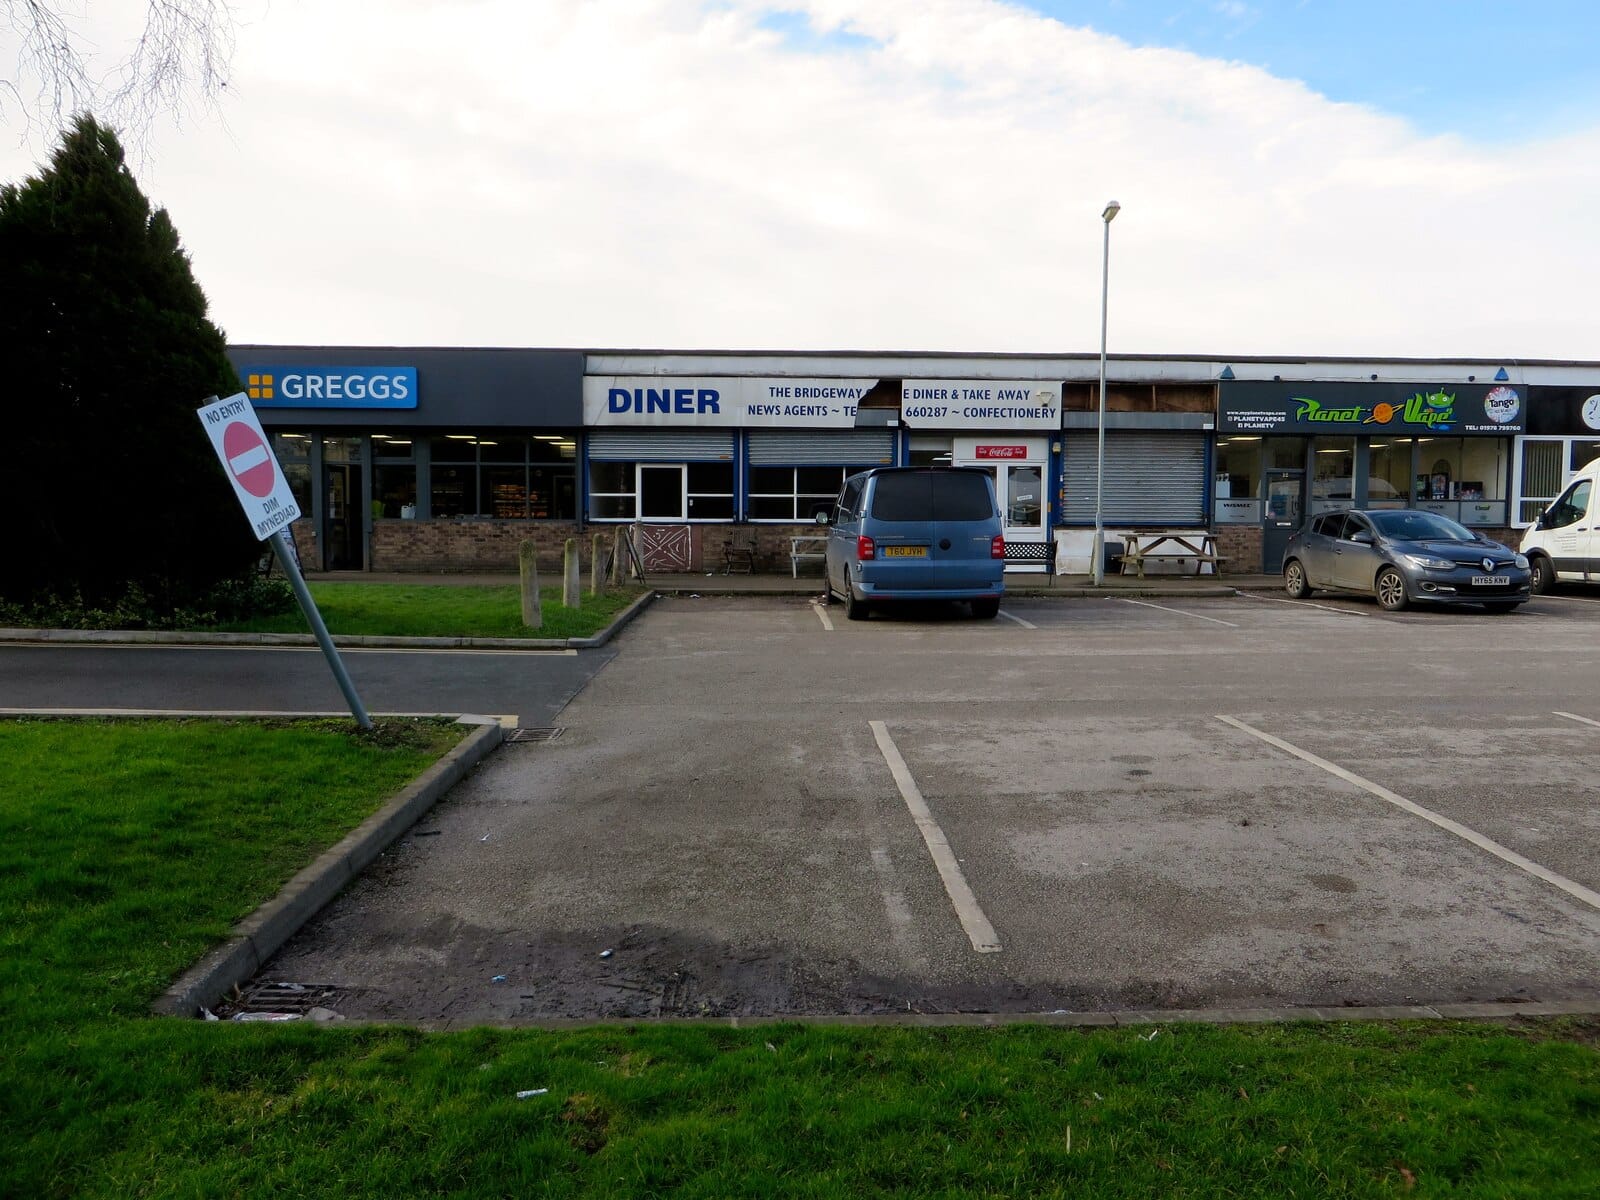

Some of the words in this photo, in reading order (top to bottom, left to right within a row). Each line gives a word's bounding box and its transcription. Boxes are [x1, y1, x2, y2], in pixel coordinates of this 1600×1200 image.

[281, 375, 409, 399] GREGGS
[769, 387, 791, 398] THE
[794, 387, 862, 399] BRIDGEWAY
[903, 388, 910, 399] E
[913, 388, 948, 400] DINER
[951, 389, 959, 400] &
[962, 389, 991, 400] TAKE
[997, 390, 1031, 400] AWAY
[608, 388, 721, 414] DINER
[1489, 399, 1514, 409] Tango
[206, 410, 220, 424] NO
[220, 400, 246, 419] ENTRY
[748, 405, 781, 416] NEWS
[784, 405, 828, 416] AGENTS
[905, 407, 948, 418] 660287
[963, 407, 1057, 418] CONFECTIONERY
[1290, 398, 1365, 422] Planet
[262, 497, 281, 514] DIM
[257, 505, 296, 536] MYNEDIAD
[890, 547, 905, 556] T60
[907, 547, 922, 556] JVH
[1474, 576, 1493, 585] HY65
